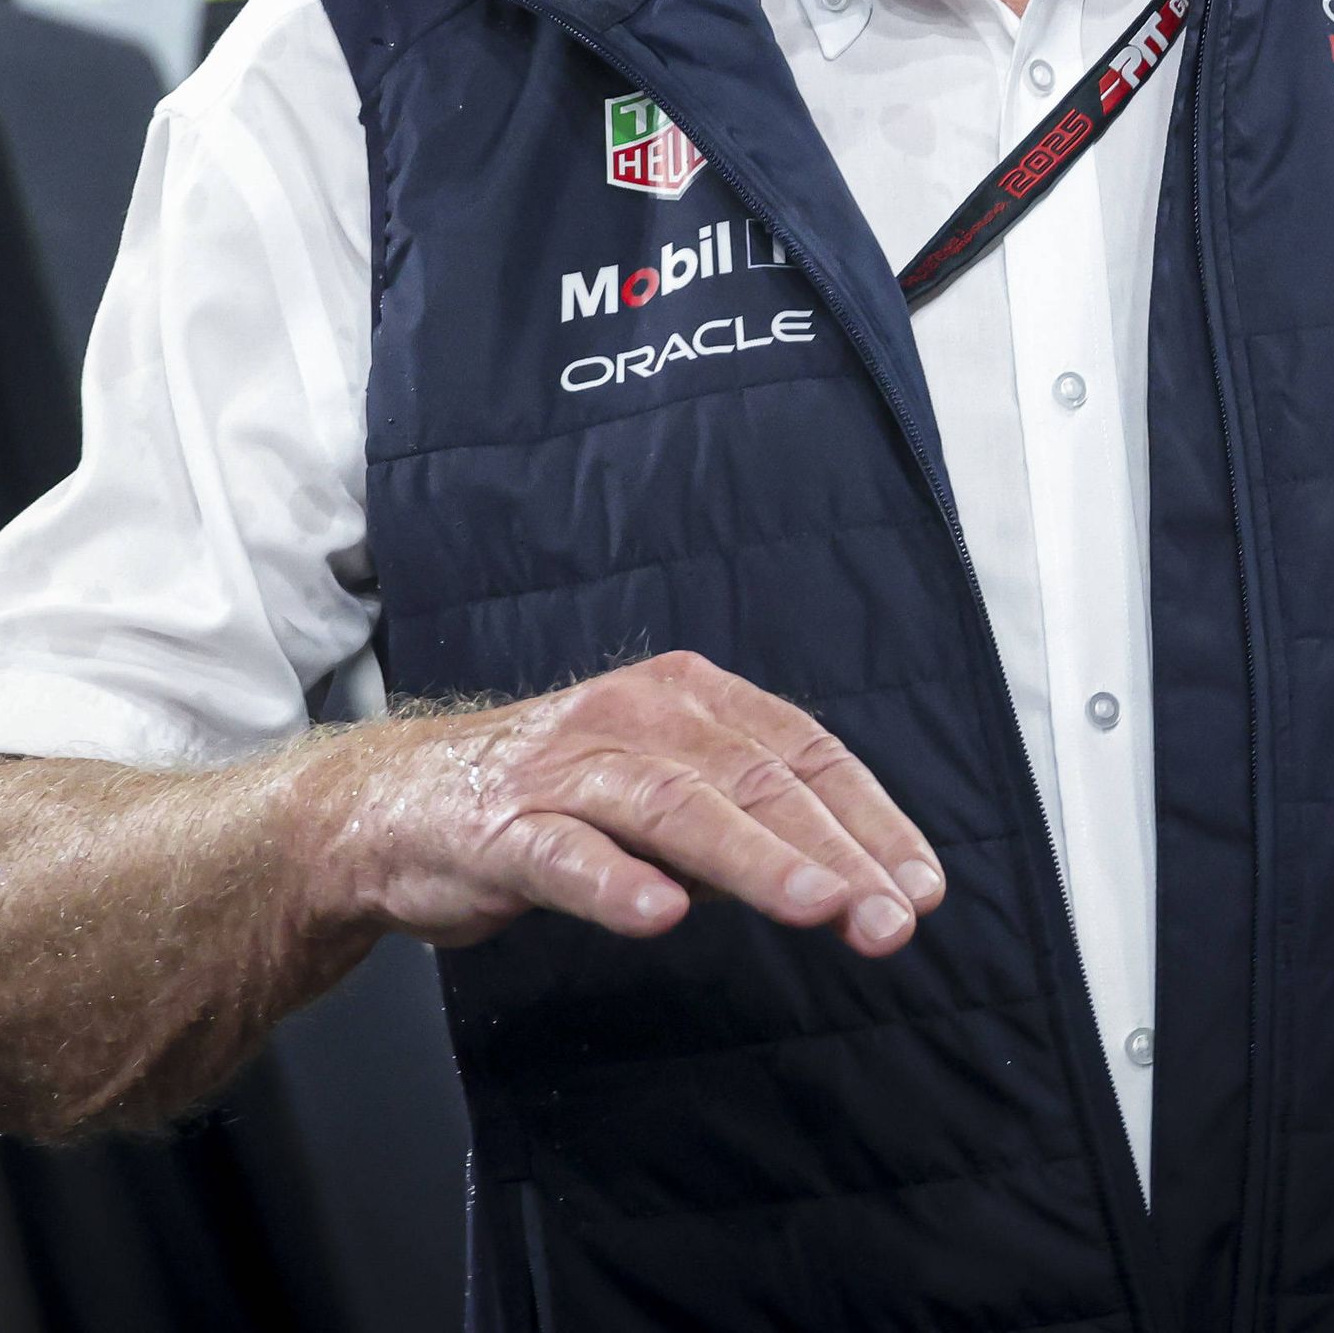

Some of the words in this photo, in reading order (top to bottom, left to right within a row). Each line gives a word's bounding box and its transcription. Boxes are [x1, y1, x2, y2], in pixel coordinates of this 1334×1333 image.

[618, 130, 703, 183] HEU
[998, 108, 1094, 199] 2025
[561, 220, 734, 324] Mobil
[560, 310, 816, 392] ORACLE
